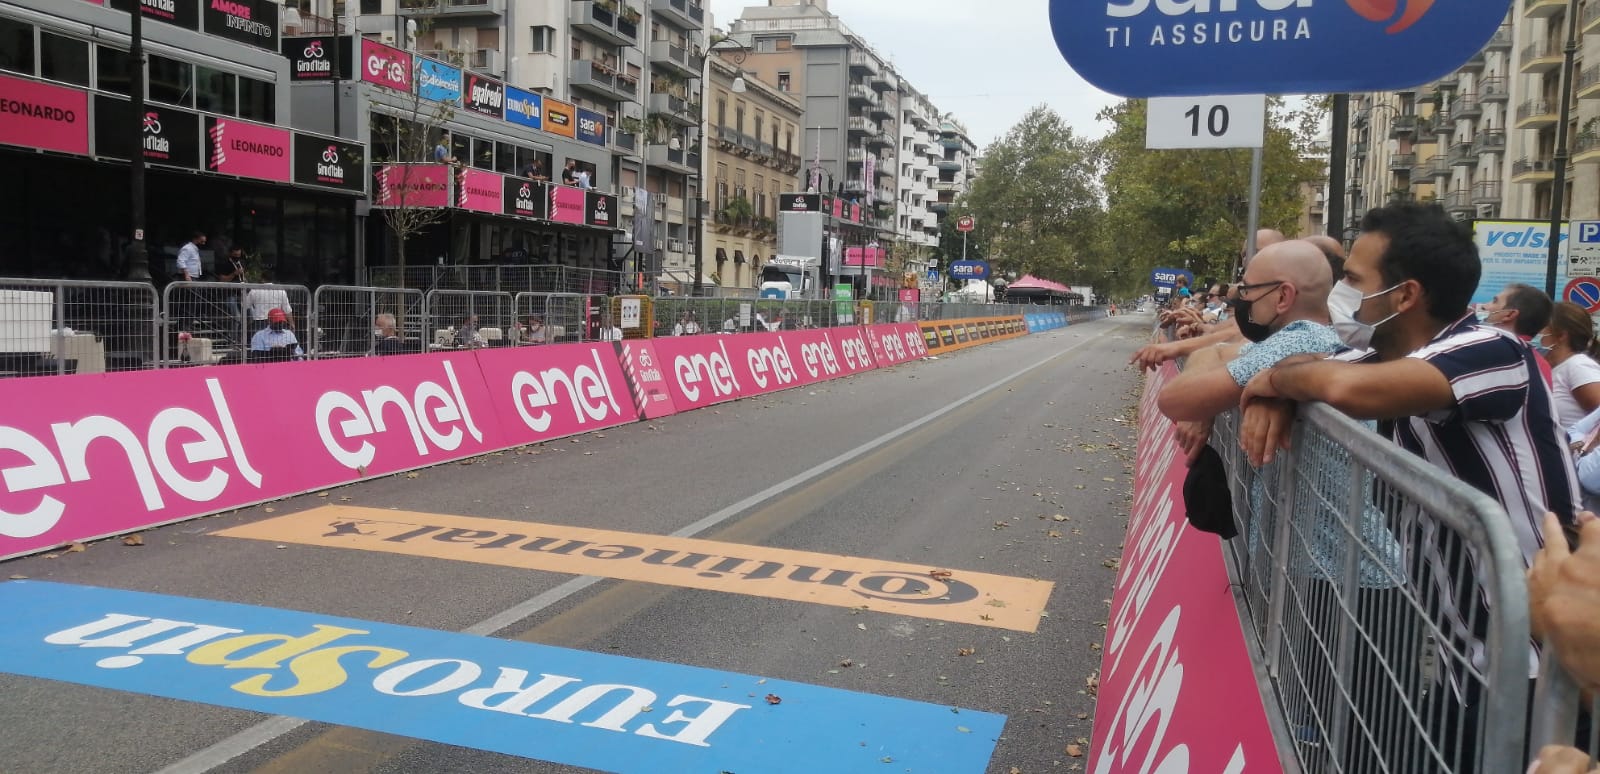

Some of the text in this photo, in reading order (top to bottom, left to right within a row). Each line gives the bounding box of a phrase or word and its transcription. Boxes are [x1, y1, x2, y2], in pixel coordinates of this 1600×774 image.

[211, 0, 251, 19] AMORE
[226, 14, 272, 38] INFINITO
[1106, 18, 1312, 48] TI ASSICURA
[580, 117, 595, 132] sara
[1184, 104, 1230, 138] 10
[231, 139, 284, 158] LEONARDO
[1486, 226, 1568, 249] vals
[1583, 224, 1598, 242] P
[953, 265, 973, 273] sara
[1154, 272, 1176, 281] sara
[801, 332, 841, 378] enel
[841, 329, 872, 371] enel
[881, 326, 907, 362] enel
[905, 325, 926, 357] enel
[674, 338, 741, 402] enel
[747, 336, 798, 389] enel
[511, 348, 621, 433] enel
[315, 360, 483, 471] enel
[0, 378, 262, 540] enel
[393, 524, 979, 605] Continental
[44, 613, 753, 748] EUROSpin
